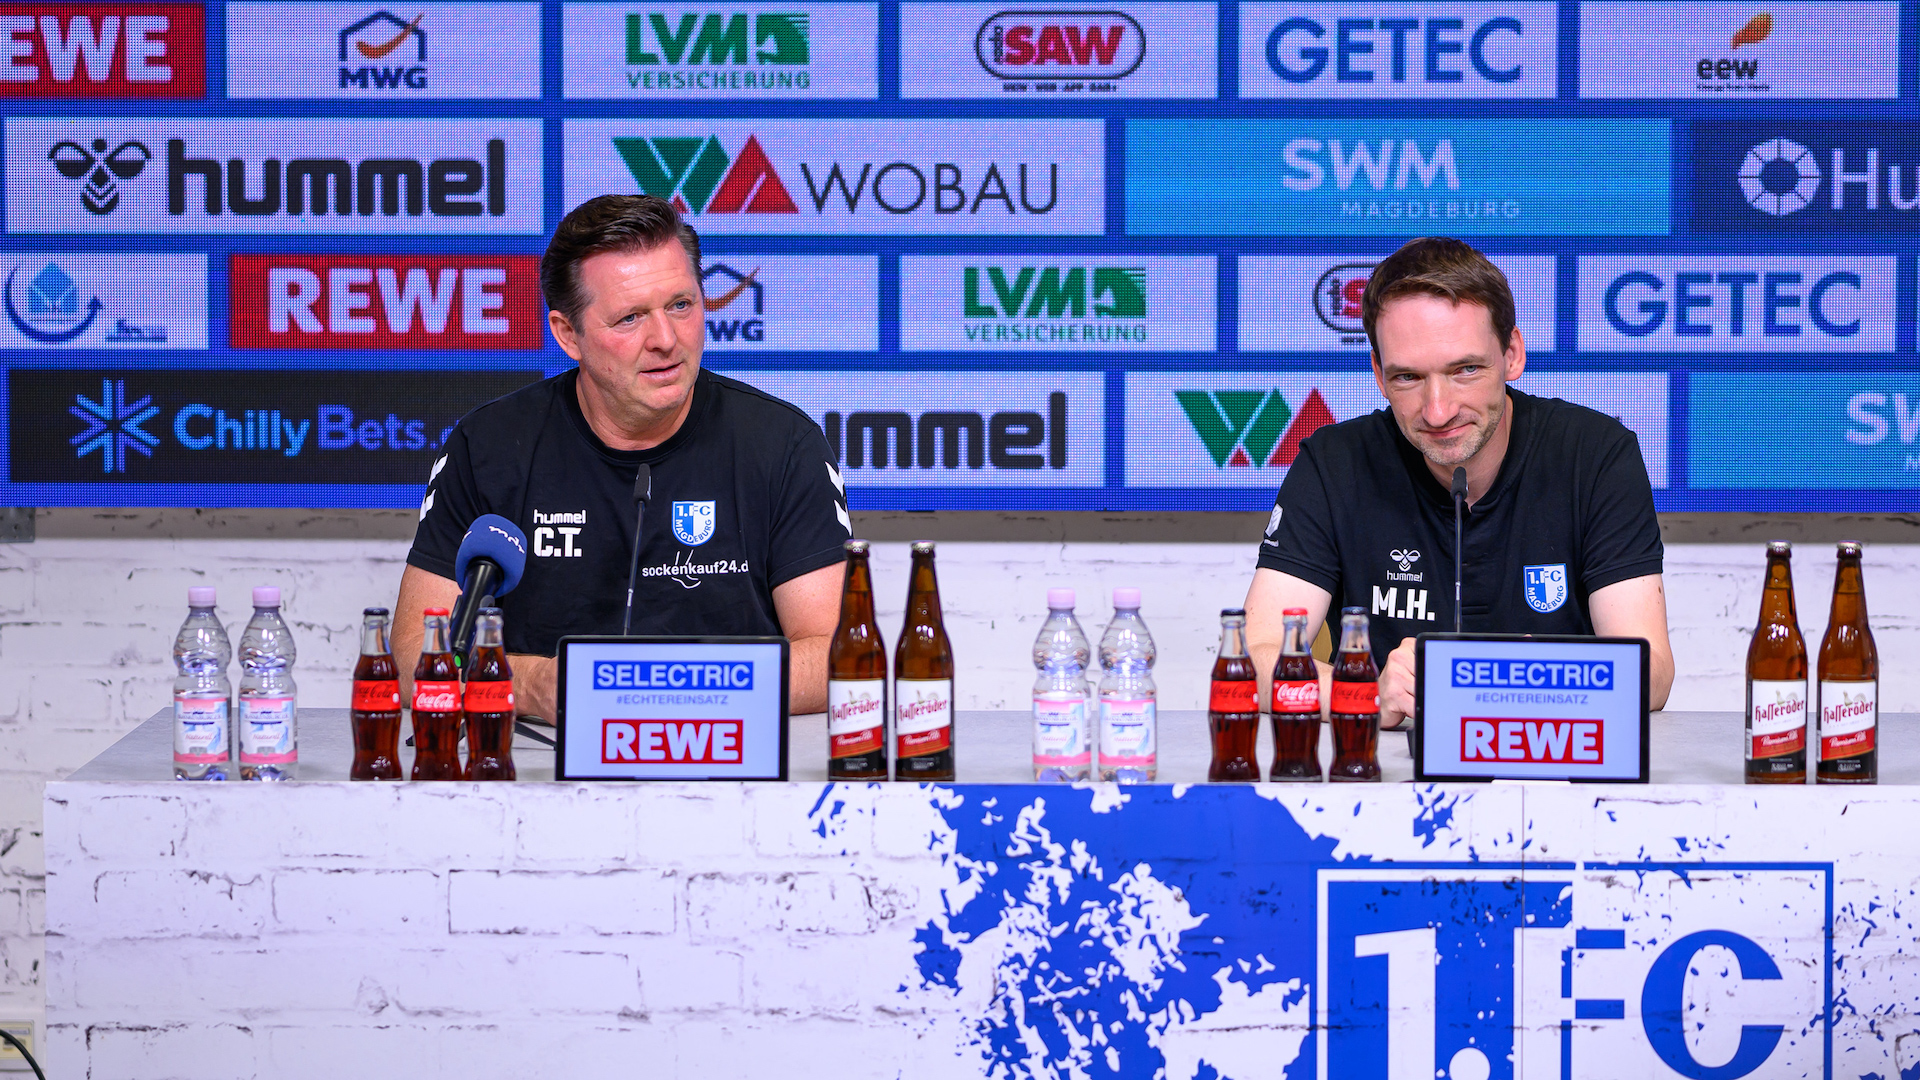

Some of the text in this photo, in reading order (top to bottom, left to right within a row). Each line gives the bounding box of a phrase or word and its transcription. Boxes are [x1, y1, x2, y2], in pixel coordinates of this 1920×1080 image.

[0, 16, 172, 82] EWE
[626, 14, 748, 65] LVM
[1004, 25, 1125, 65] SAW
[1265, 16, 1523, 84] GETEC
[339, 68, 427, 89] MWG
[627, 72, 810, 90] VERSICHERUNG
[1697, 58, 1757, 79] eew
[167, 139, 505, 216] hummel
[1282, 138, 1460, 190] SWM
[800, 162, 1057, 214] WOBAU
[1341, 200, 1521, 219] MAGDEBURG
[269, 267, 510, 334] REWE
[964, 266, 1086, 318] LVM
[1604, 271, 1862, 337] GETEC
[704, 320, 763, 341] WG
[964, 324, 1147, 343] VERSICHERUNG
[533, 508, 587, 525] hummel
[675, 518, 712, 543] MAGDEBURG
[533, 526, 583, 558] C.T.
[1386, 569, 1423, 583] hummel
[1371, 585, 1436, 621] M.H.
[1527, 585, 1564, 611] MAGDEBURG
[596, 663, 750, 688] SELECTRIC
[1455, 660, 1610, 688] SELECTRIC
[616, 694, 729, 706] #ECHTEREINSATZ
[1475, 692, 1588, 705] #ECHTEREINSATZ
[605, 722, 739, 760] REWE
[1464, 720, 1599, 761] REWE
